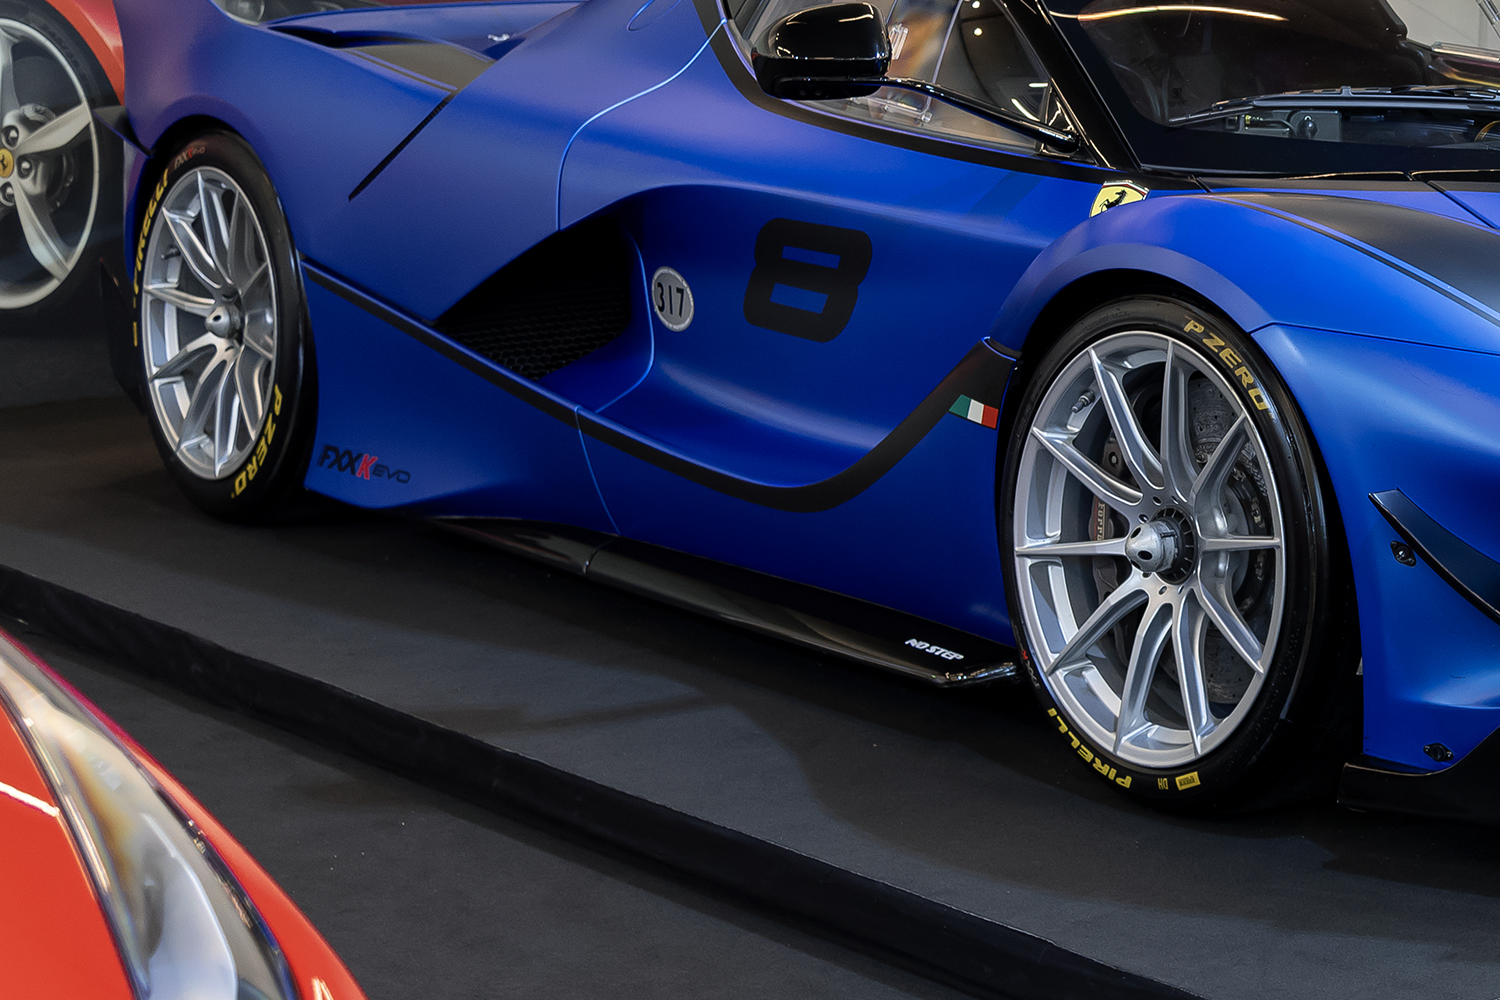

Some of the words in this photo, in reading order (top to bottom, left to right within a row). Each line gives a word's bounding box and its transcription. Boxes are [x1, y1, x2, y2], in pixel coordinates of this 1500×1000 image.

[656, 282, 685, 318] 317
[743, 217, 873, 343] 8
[1047, 708, 1132, 789] PIRELLI
